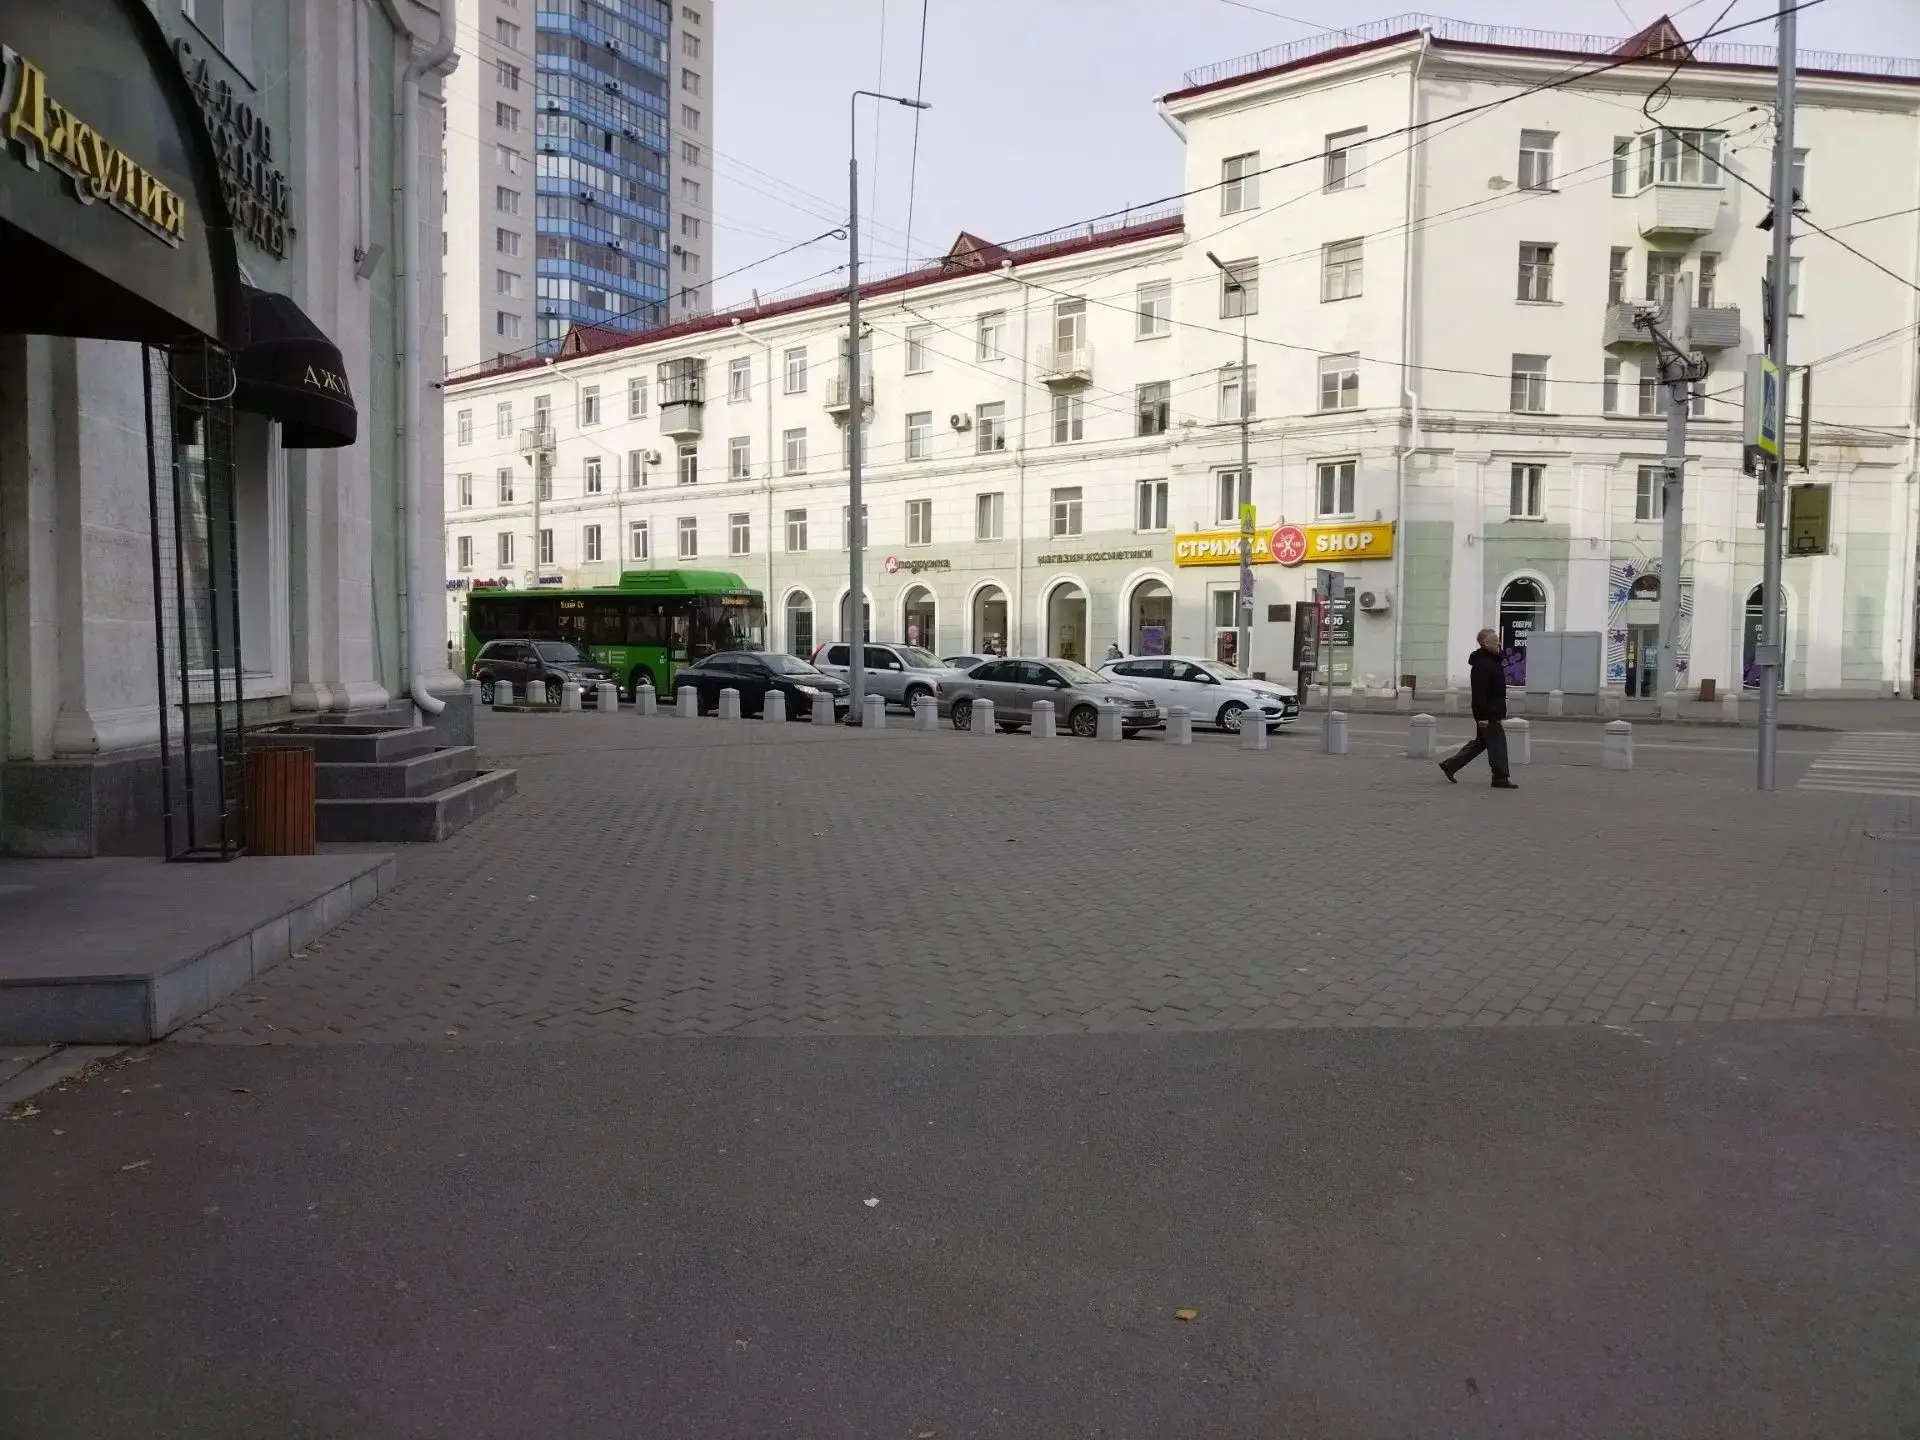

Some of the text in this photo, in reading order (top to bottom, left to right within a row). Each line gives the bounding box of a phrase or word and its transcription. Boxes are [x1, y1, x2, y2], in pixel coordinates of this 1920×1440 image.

[303, 364, 350, 398] ДЖУ
[1177, 532, 1373, 558] СТРИЖА SHOP
